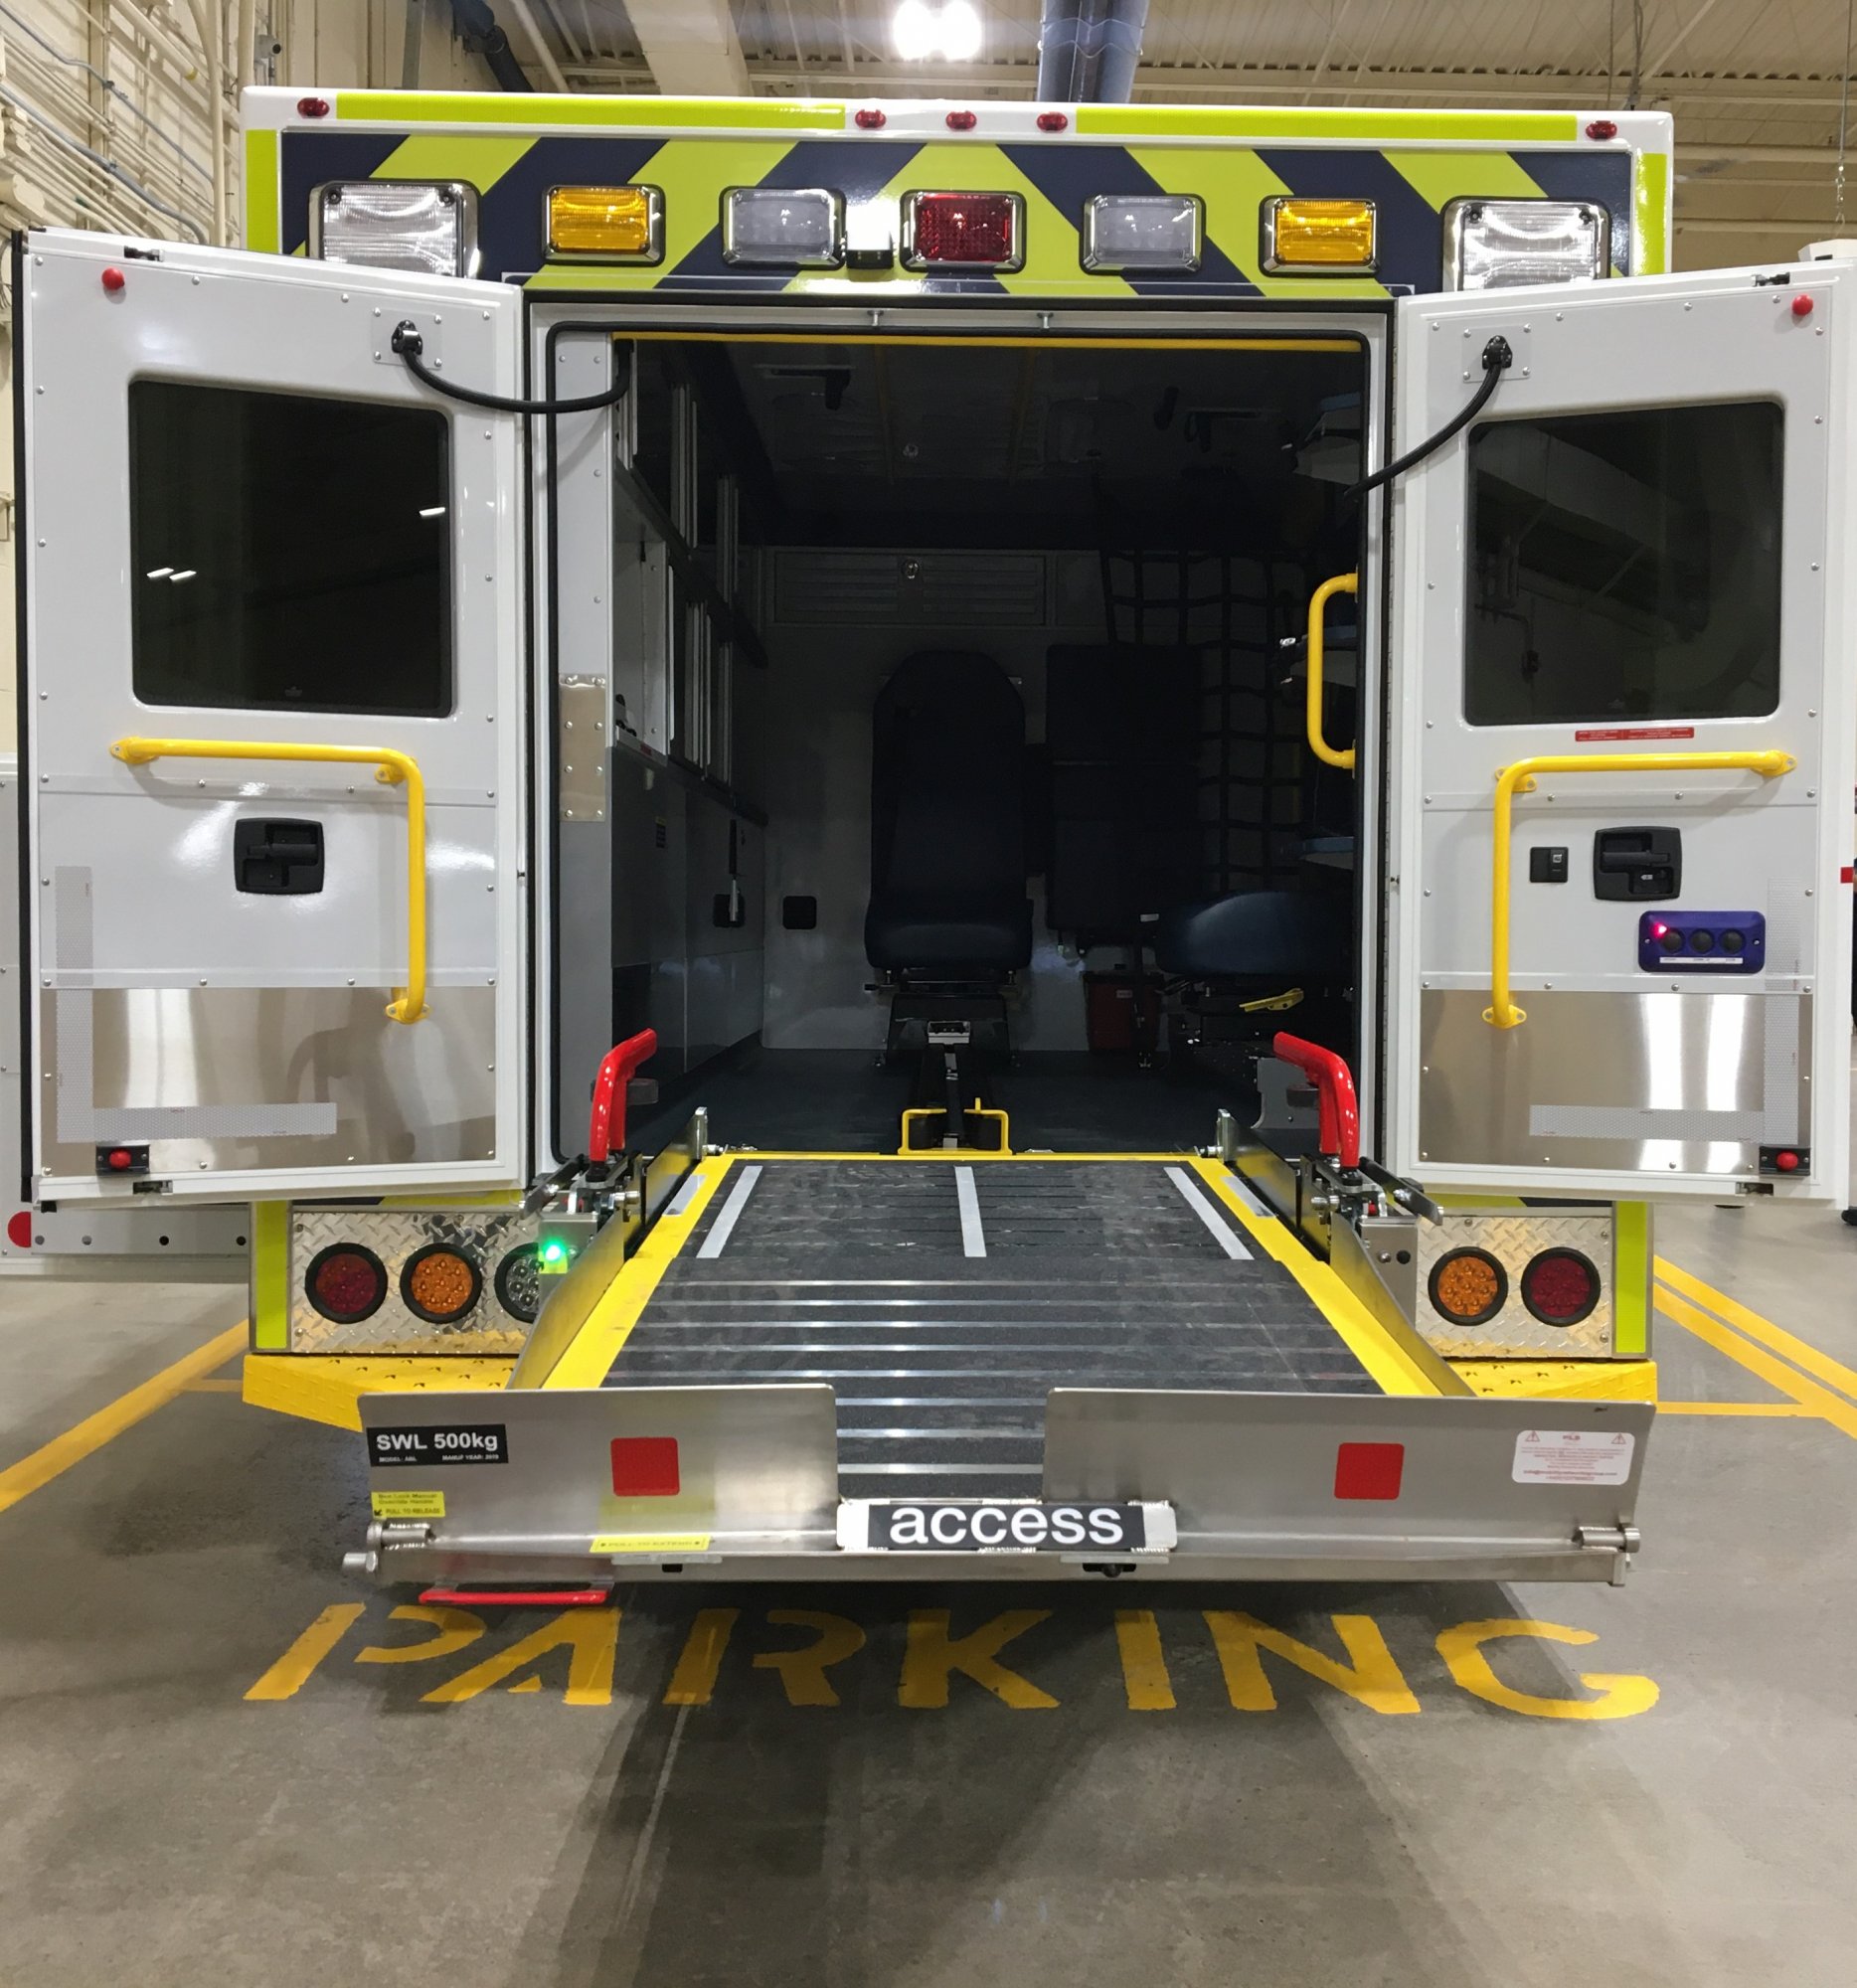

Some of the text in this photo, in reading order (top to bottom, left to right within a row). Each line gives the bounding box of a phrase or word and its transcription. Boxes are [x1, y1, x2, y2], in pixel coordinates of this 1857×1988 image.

[376, 1431, 498, 1451] SWL 500kg
[890, 1507, 1123, 1544] access
[243, 1601, 1661, 1720] PARKING
